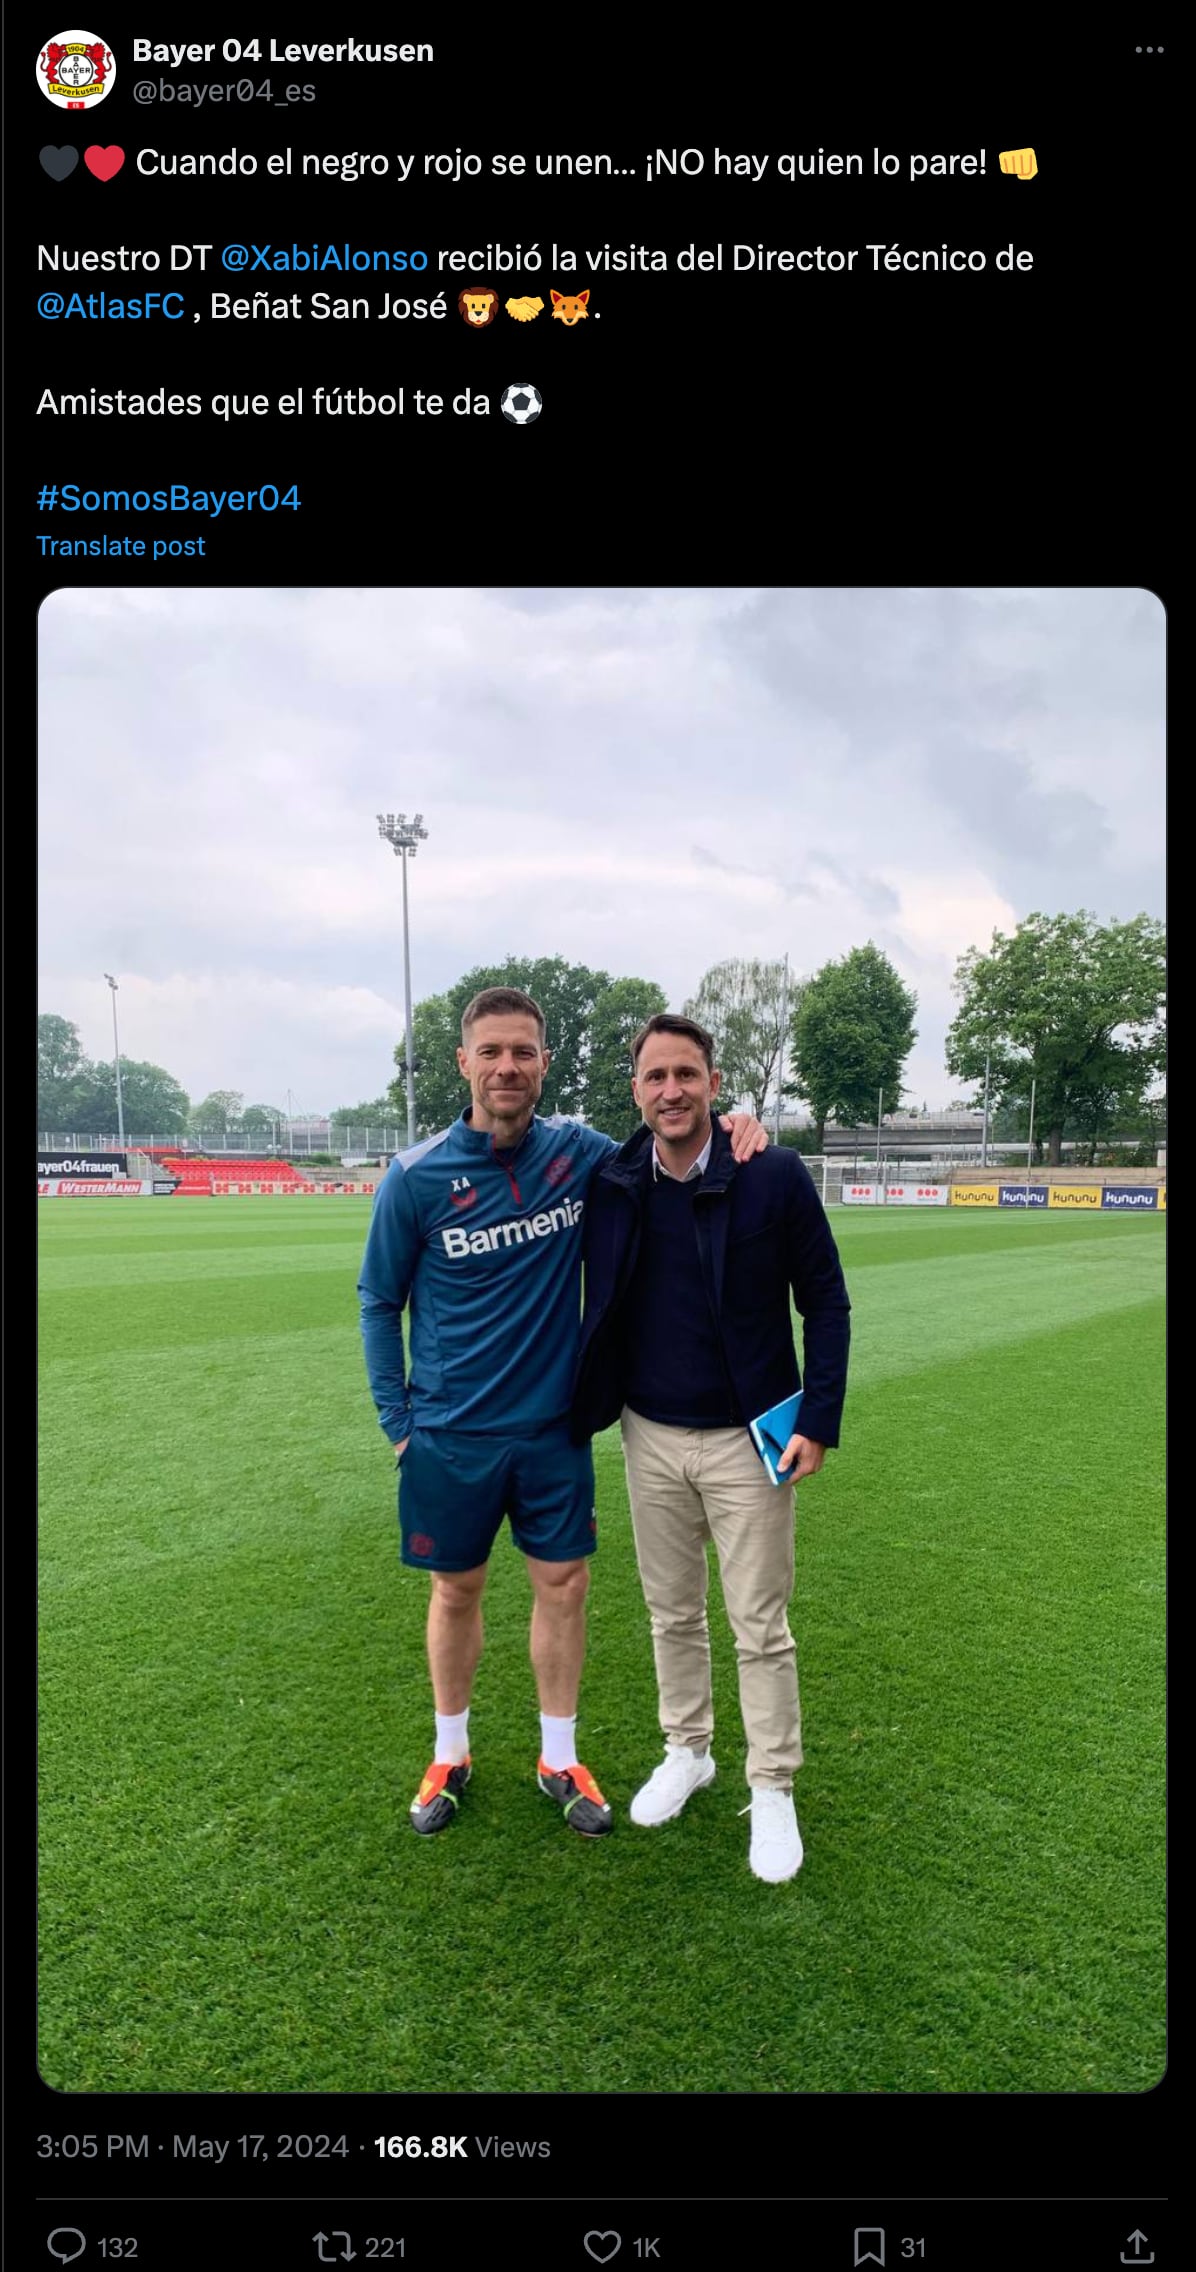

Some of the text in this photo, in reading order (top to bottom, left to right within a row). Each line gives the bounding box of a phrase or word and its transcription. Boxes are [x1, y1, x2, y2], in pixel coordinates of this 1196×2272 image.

[955, 1190, 994, 1202] kununu
[1054, 1191, 1097, 1204] kununu
[1106, 1191, 1153, 1205] kununu
